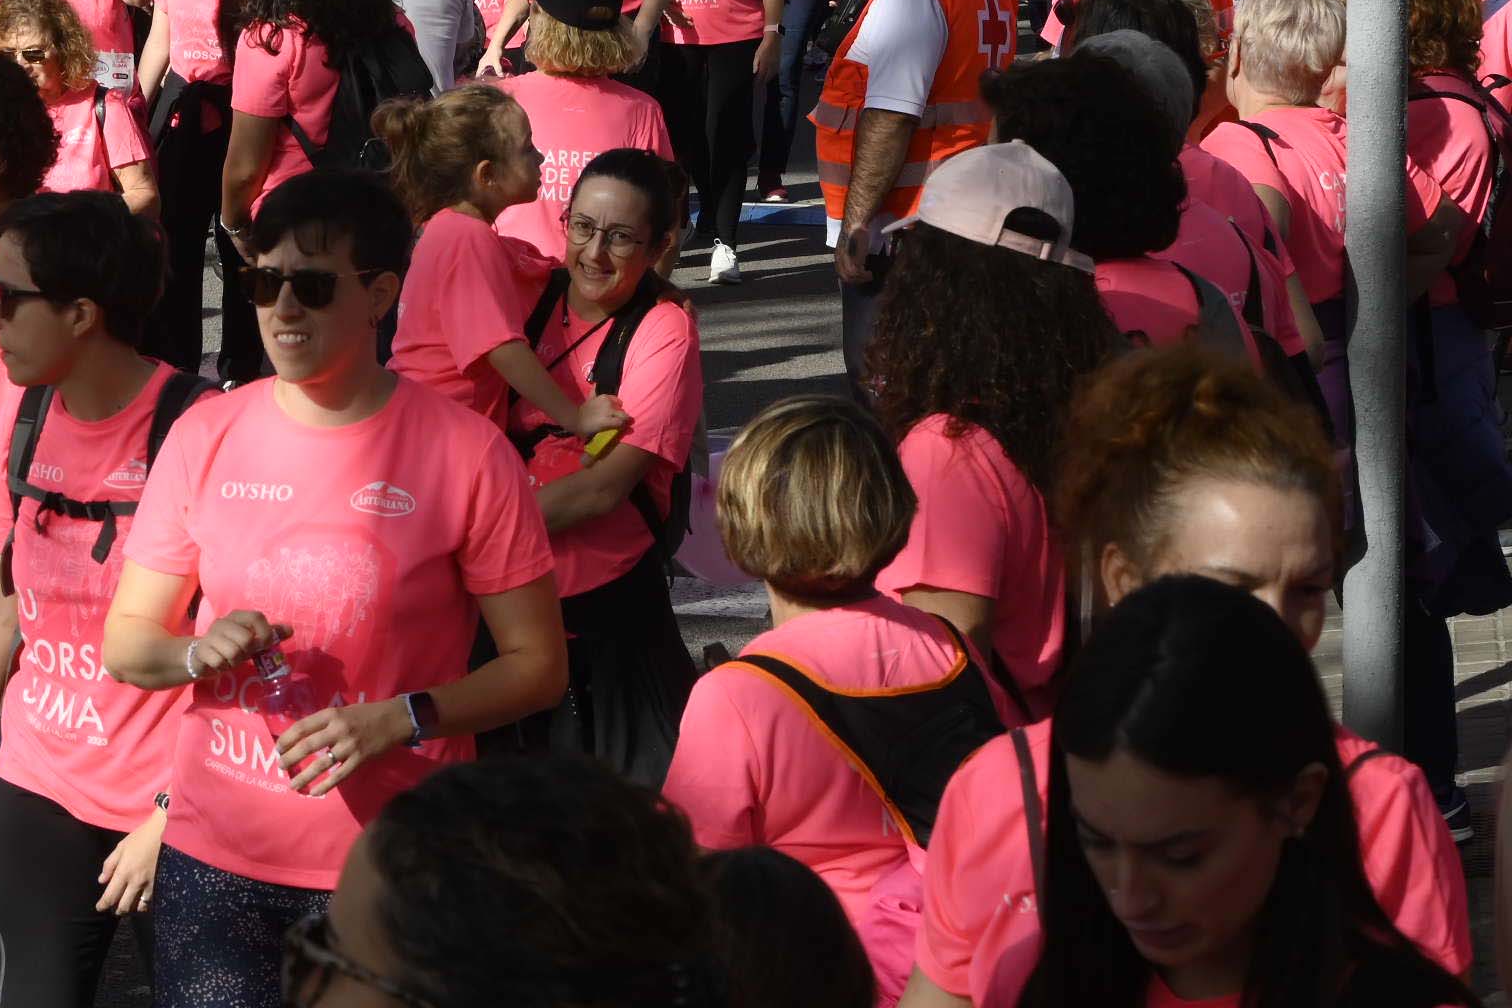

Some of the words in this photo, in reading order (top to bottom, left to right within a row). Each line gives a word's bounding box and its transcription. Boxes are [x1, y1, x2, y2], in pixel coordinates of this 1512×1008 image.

[545, 167, 570, 185] DE
[220, 480, 294, 502] OYSHO
[20, 588, 38, 621] U
[209, 718, 286, 779] SUM
